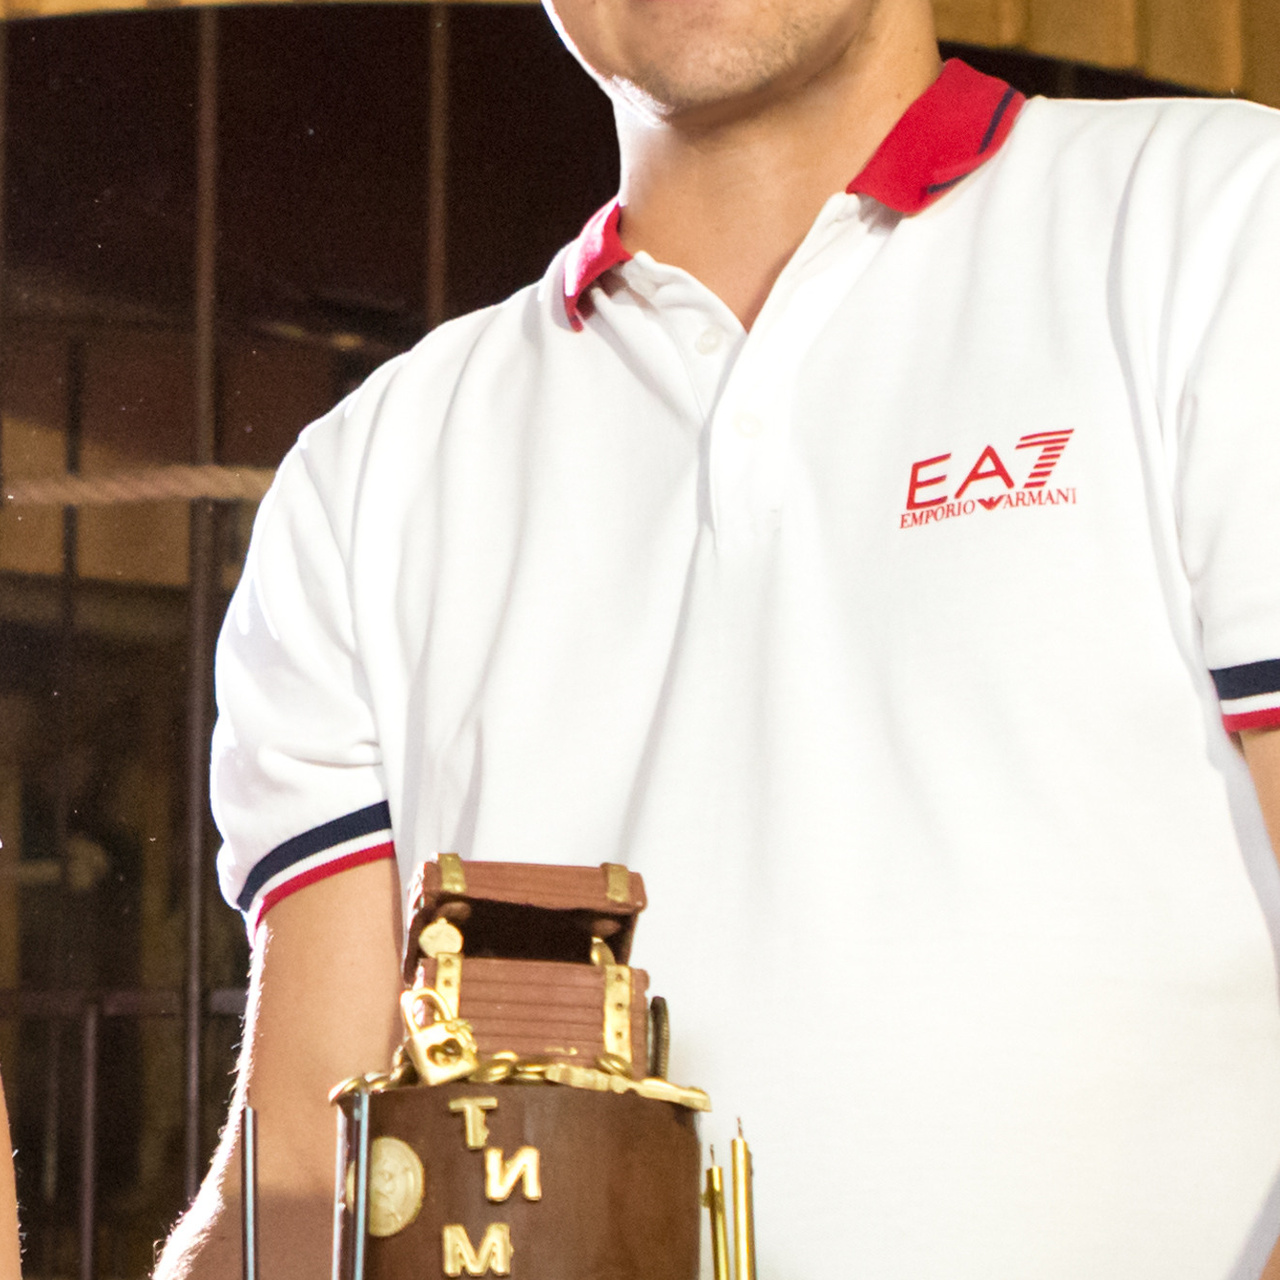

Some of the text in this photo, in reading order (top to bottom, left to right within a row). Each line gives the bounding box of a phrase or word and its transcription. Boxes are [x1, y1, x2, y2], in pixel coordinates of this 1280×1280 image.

[905, 428, 1075, 511] EA7
[898, 487, 1078, 530] EMPORIO ARMANI
